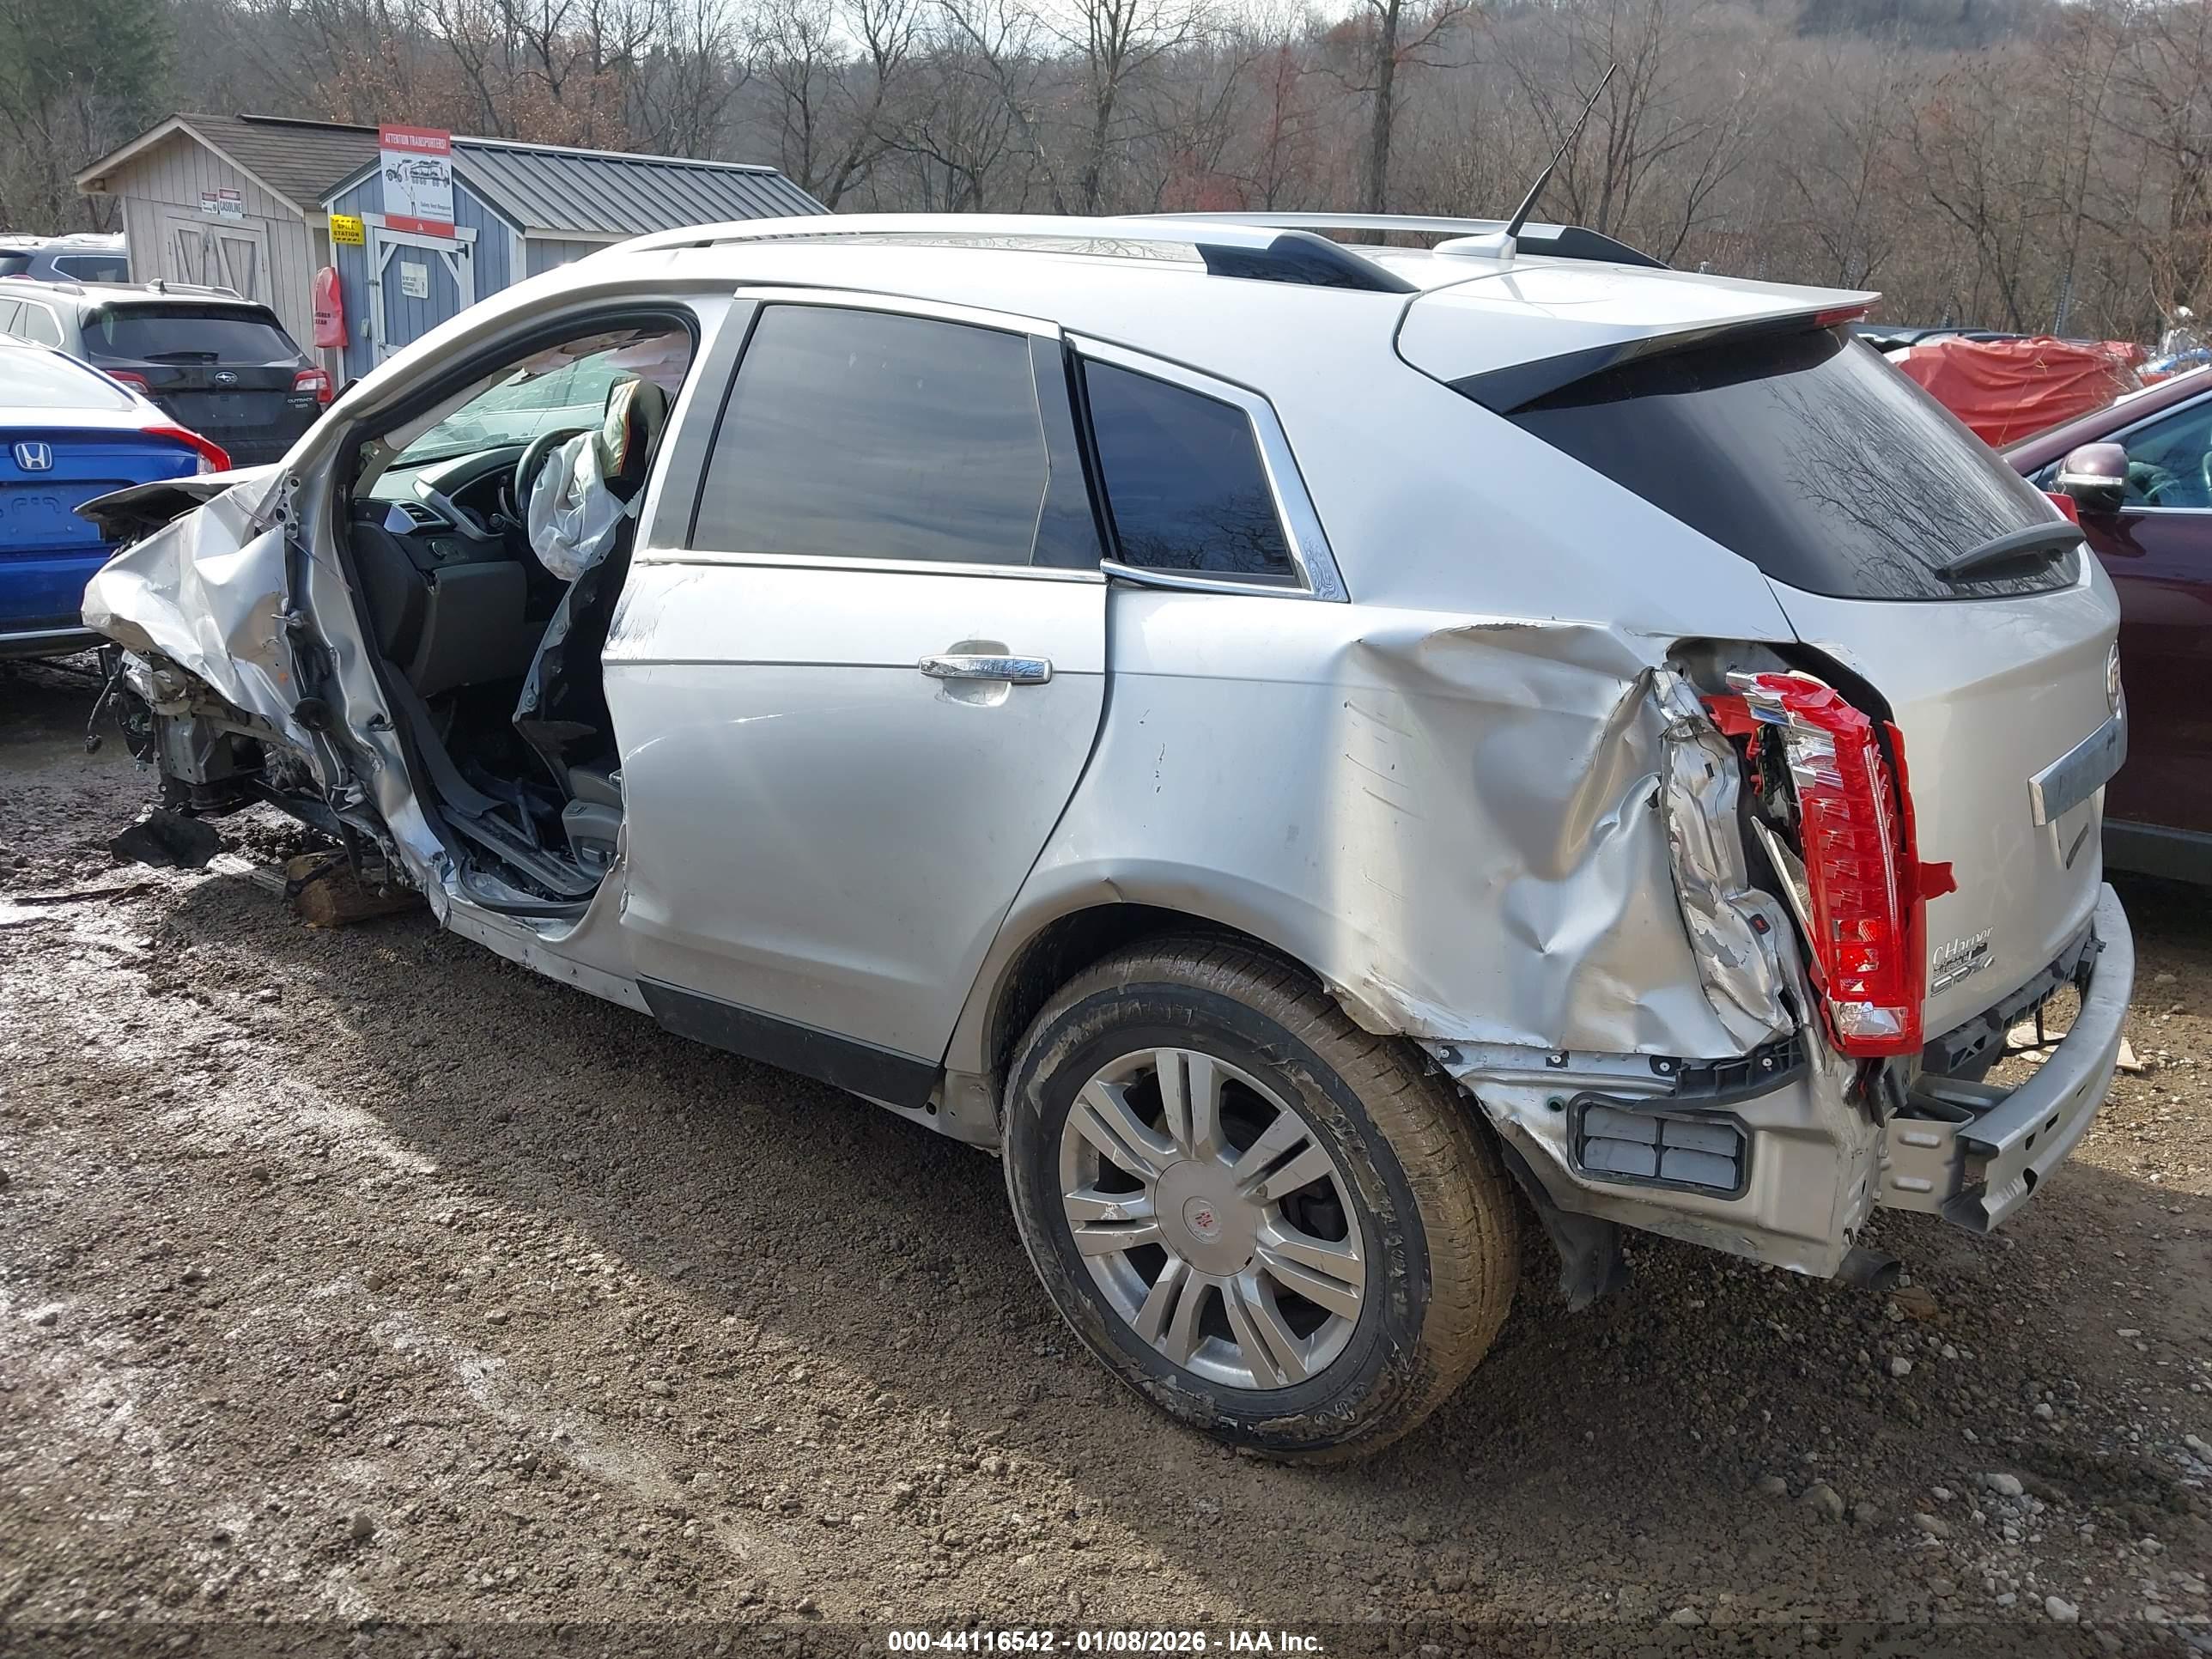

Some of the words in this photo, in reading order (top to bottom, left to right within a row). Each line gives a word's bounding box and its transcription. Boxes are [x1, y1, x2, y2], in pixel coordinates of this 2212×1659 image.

[385, 132, 410, 145] ATTENTION
[410, 136, 447, 149] TRANSPORTERS!
[219, 199, 242, 213] GASOLINE
